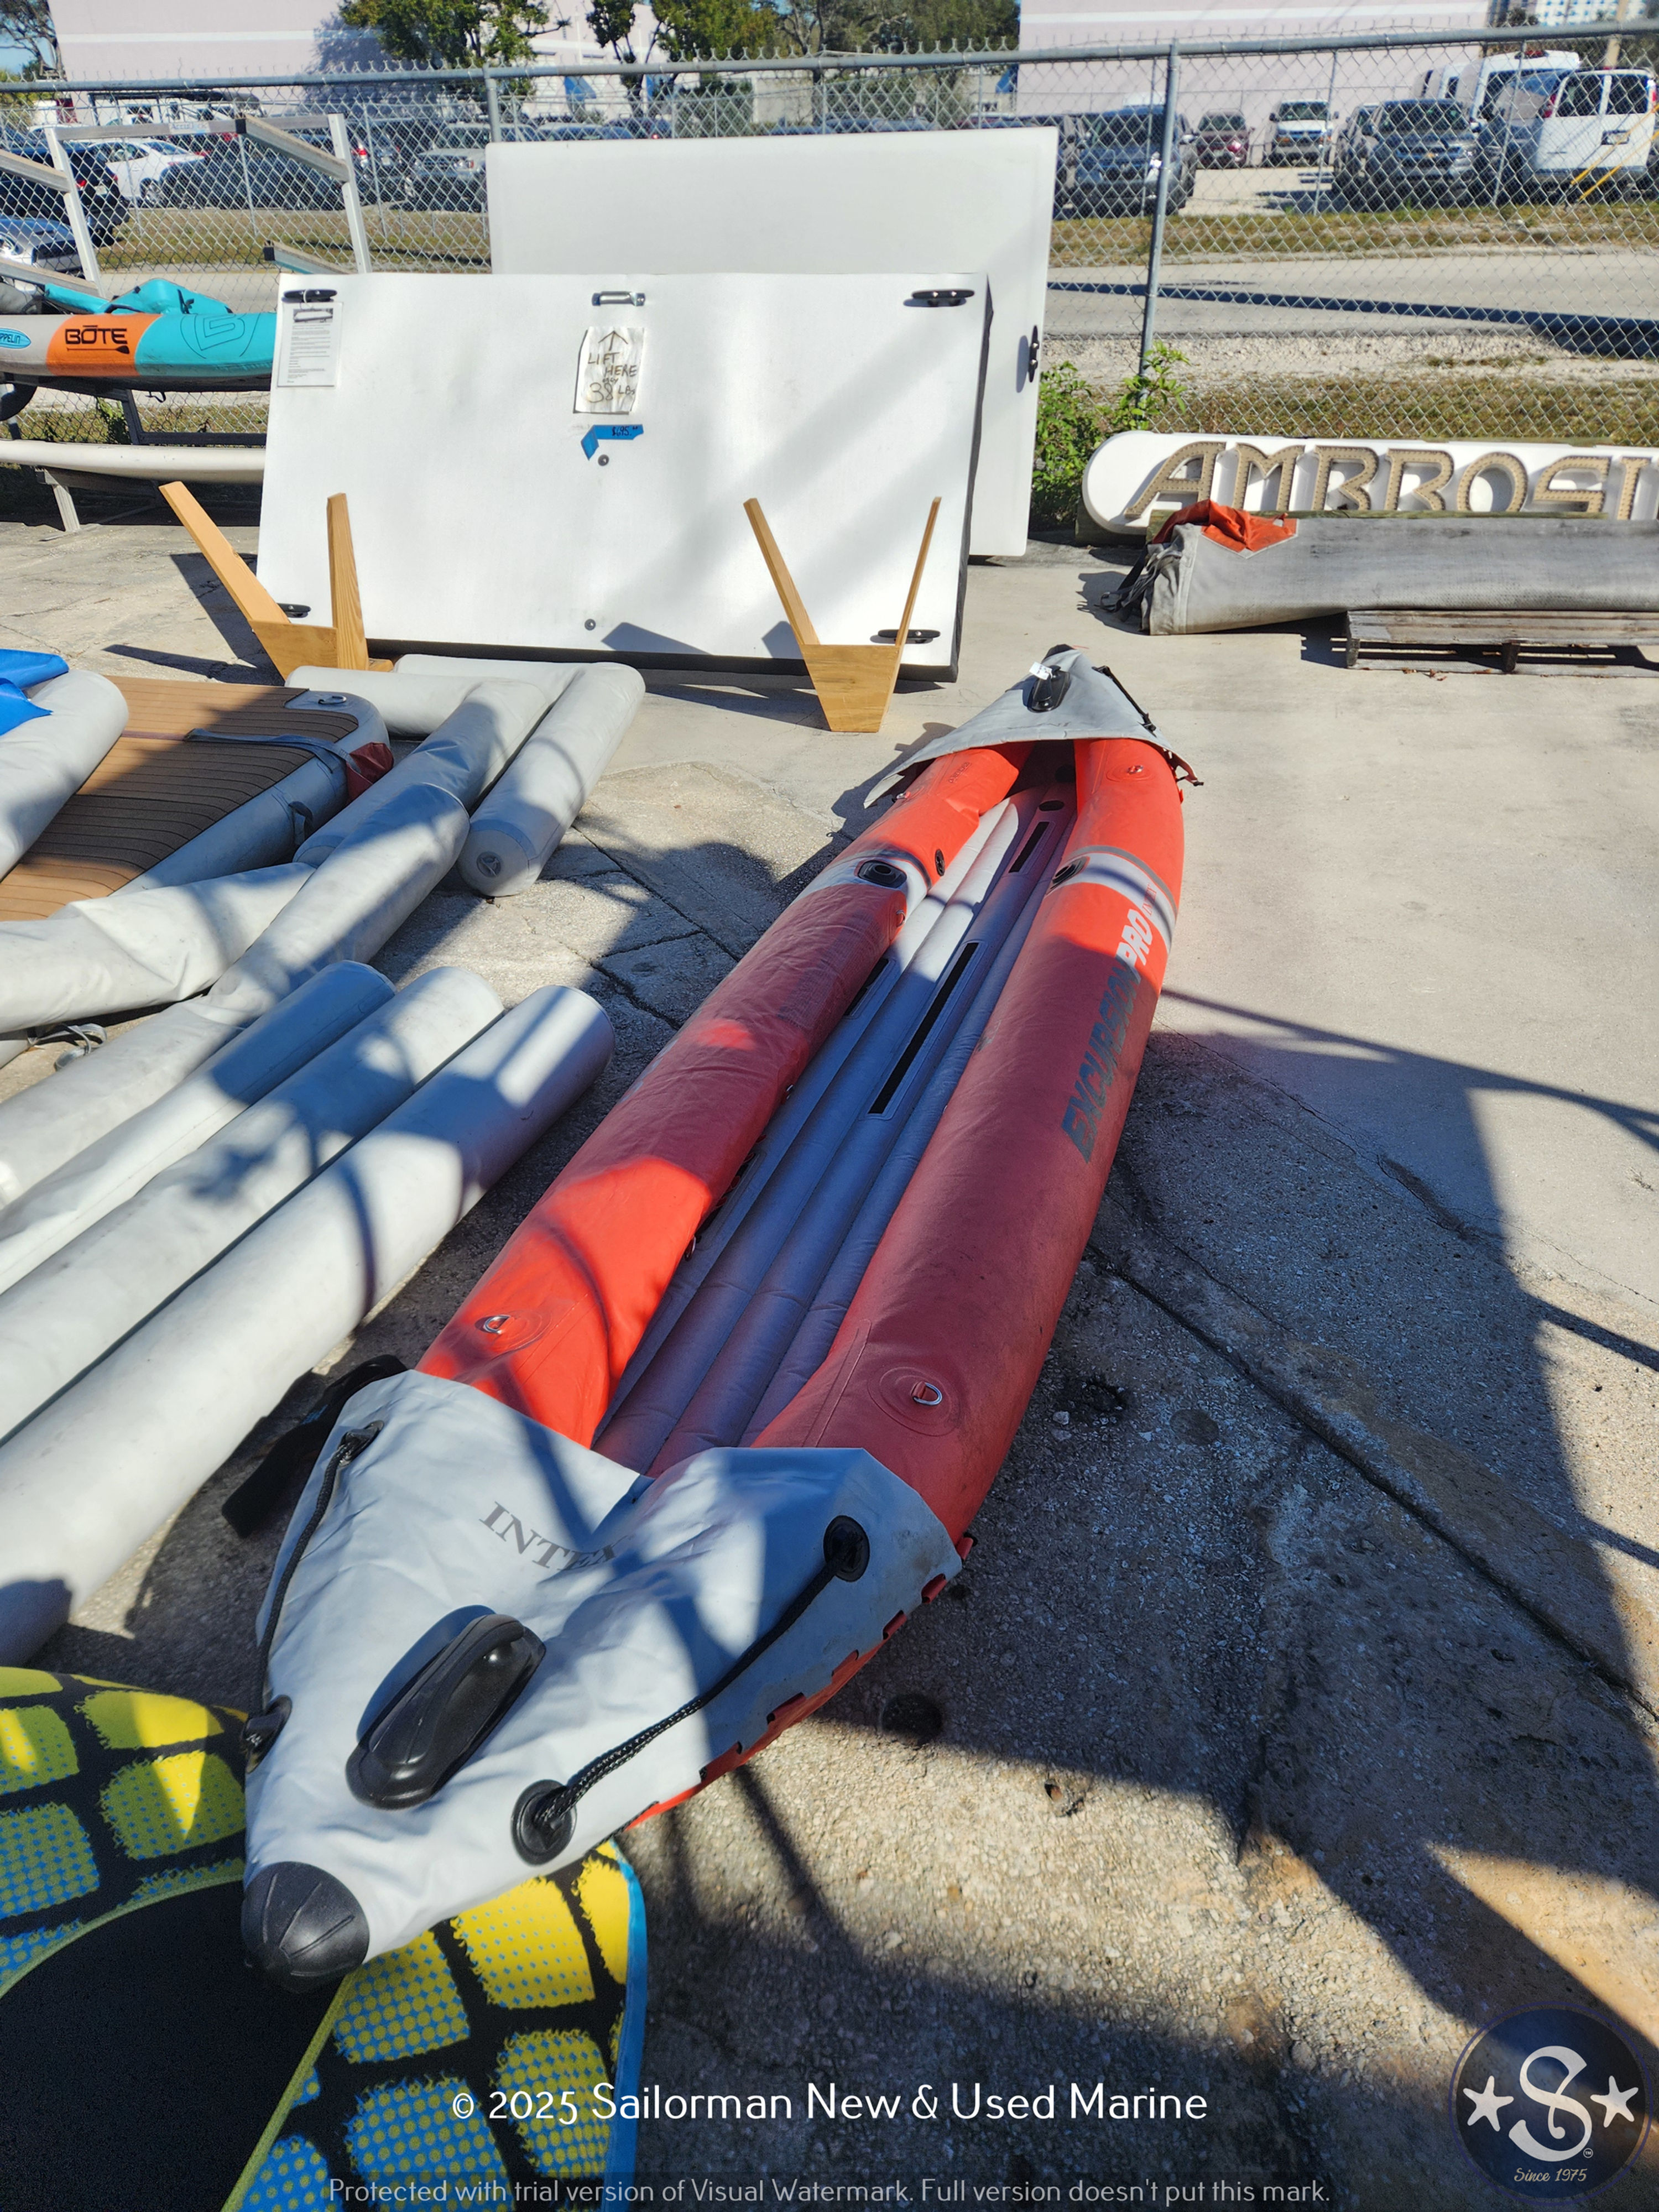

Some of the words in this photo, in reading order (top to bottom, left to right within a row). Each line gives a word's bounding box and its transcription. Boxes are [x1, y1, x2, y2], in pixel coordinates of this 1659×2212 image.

[588, 352, 620, 364] LIFT
[604, 364, 637, 377] HERE
[589, 382, 613, 403] 38
[1124, 442, 1652, 520] AMBROSI
[1061, 966, 1139, 1165] EXCURSION
[1114, 908, 1153, 985] PRO
